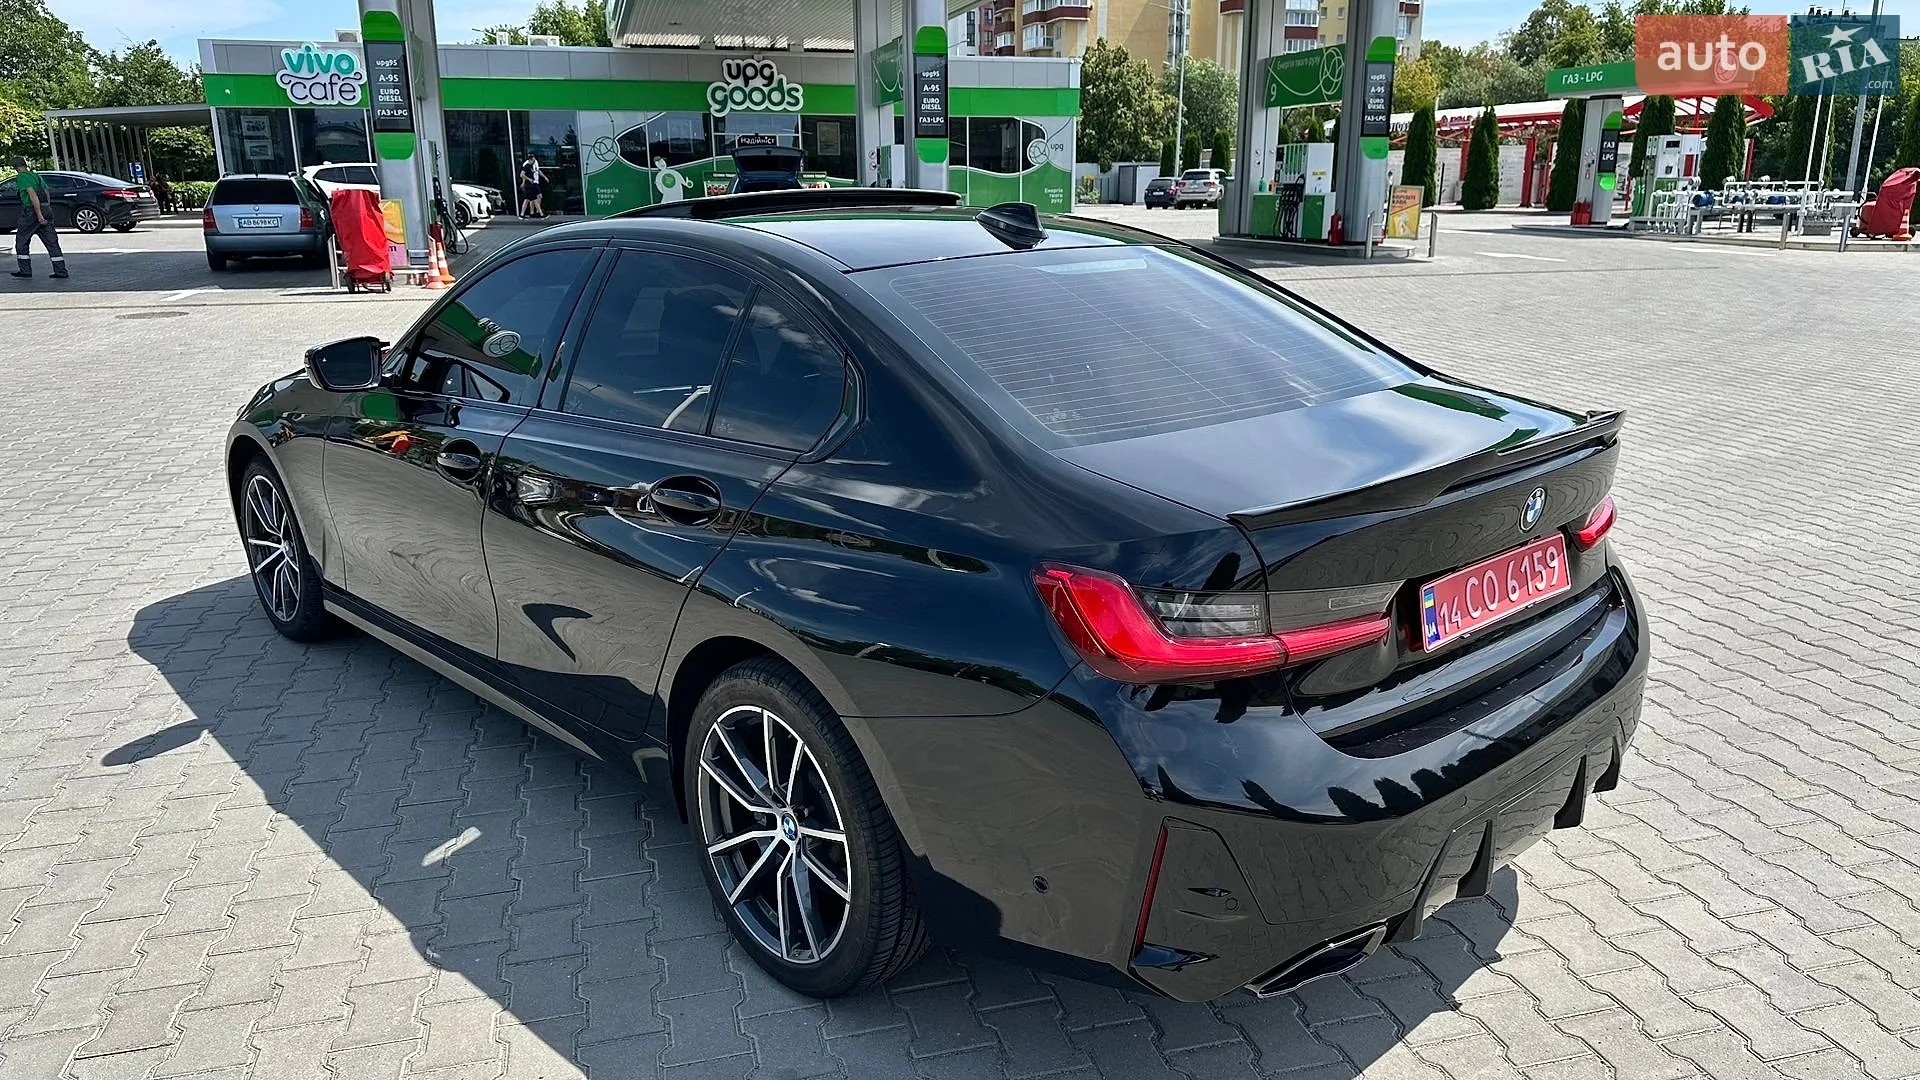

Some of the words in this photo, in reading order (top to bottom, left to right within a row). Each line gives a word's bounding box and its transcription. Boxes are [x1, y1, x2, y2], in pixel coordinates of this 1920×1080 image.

[285, 45, 355, 75] vivo
[376, 59, 398, 67] upg95
[726, 62, 775, 88] upg
[378, 94, 403, 102] DIESEL
[710, 77, 800, 113] goods
[1270, 84, 1277, 102] 9
[1050, 143, 1064, 151] upg
[1440, 595, 1462, 634] 14
[1465, 569, 1499, 619] CO
[1506, 546, 1558, 602] 6159
[1426, 621, 1437, 638] UA
